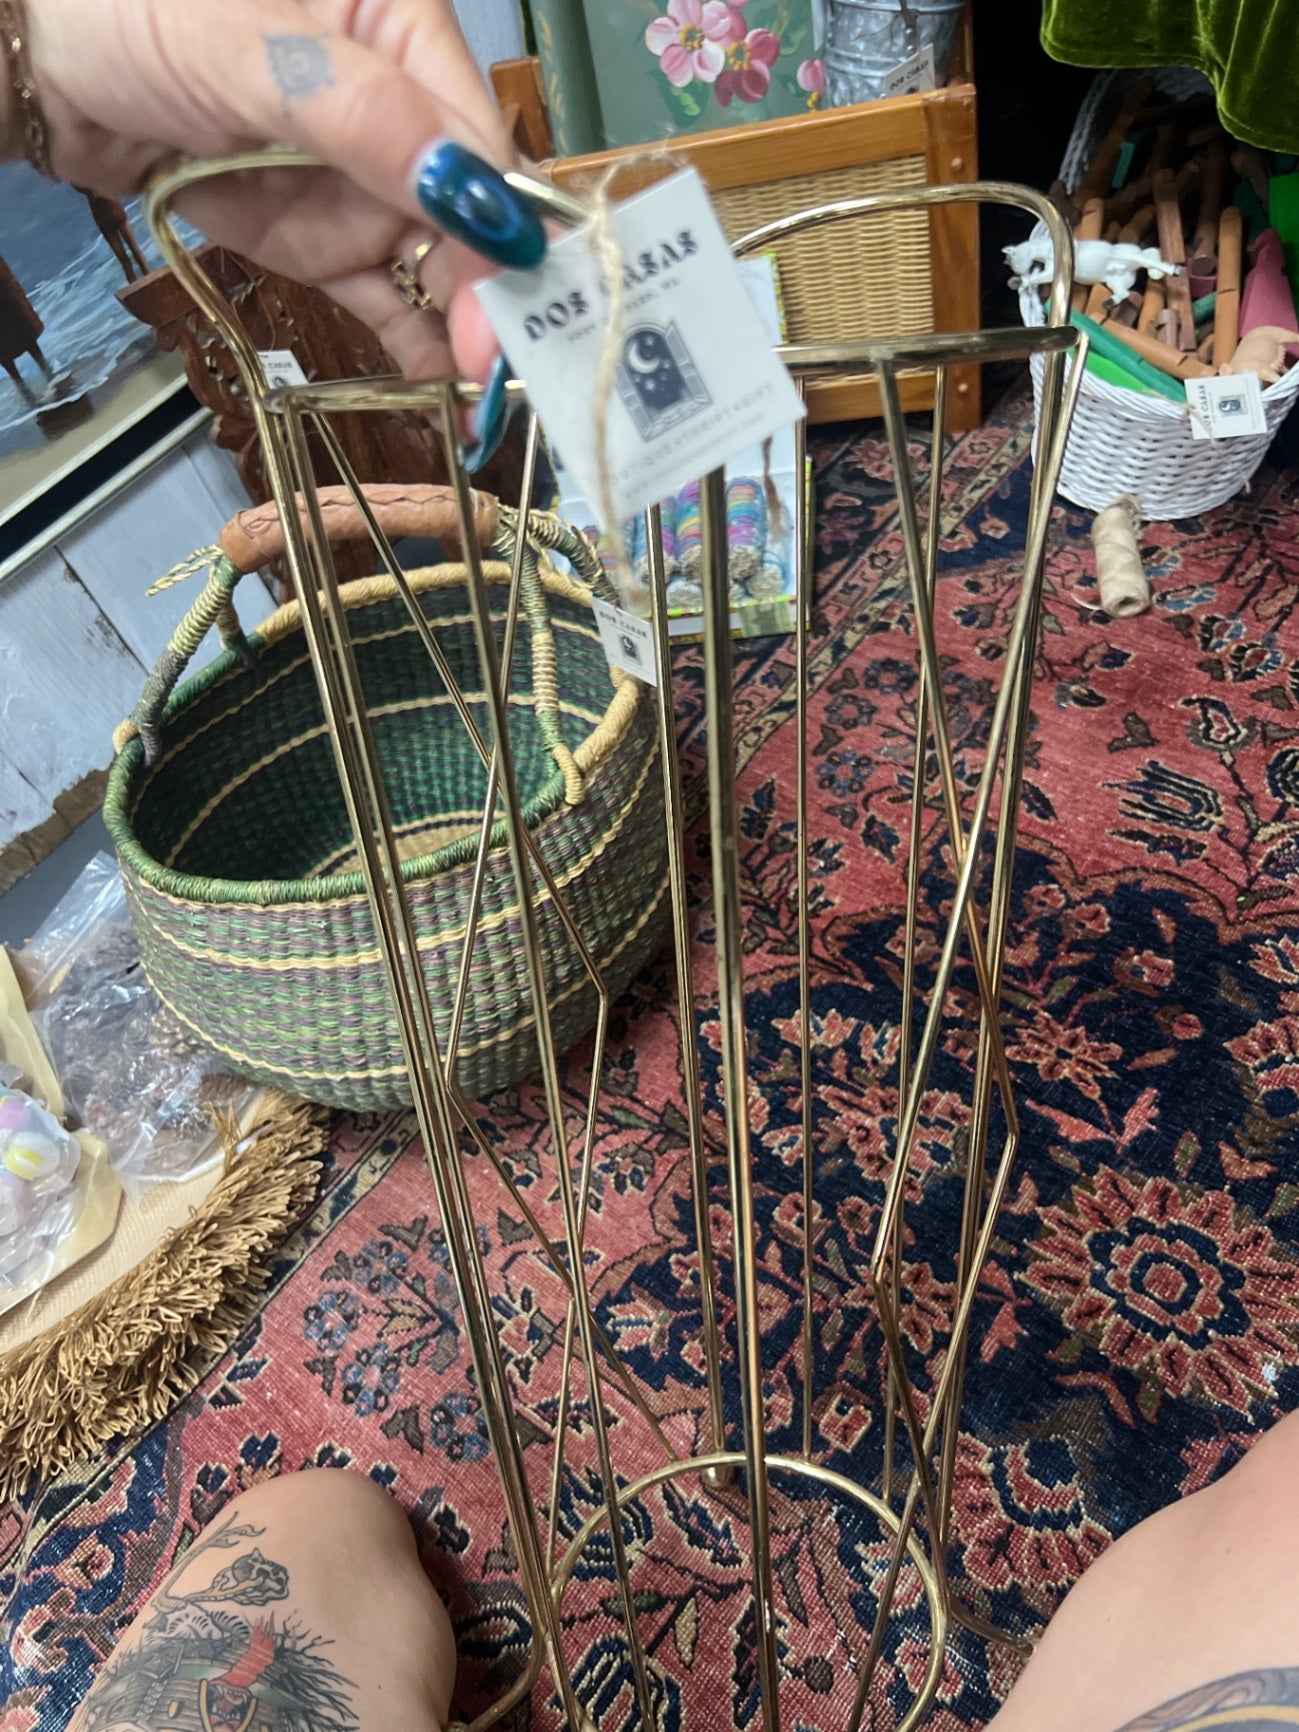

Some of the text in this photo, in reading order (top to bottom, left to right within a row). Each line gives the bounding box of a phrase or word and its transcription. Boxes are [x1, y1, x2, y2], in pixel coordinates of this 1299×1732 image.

[523, 289, 590, 343] DOS
[568, 323, 597, 343] PORT
[602, 290, 658, 324] OHARD,
[610, 444, 672, 483] OUTIQUE
